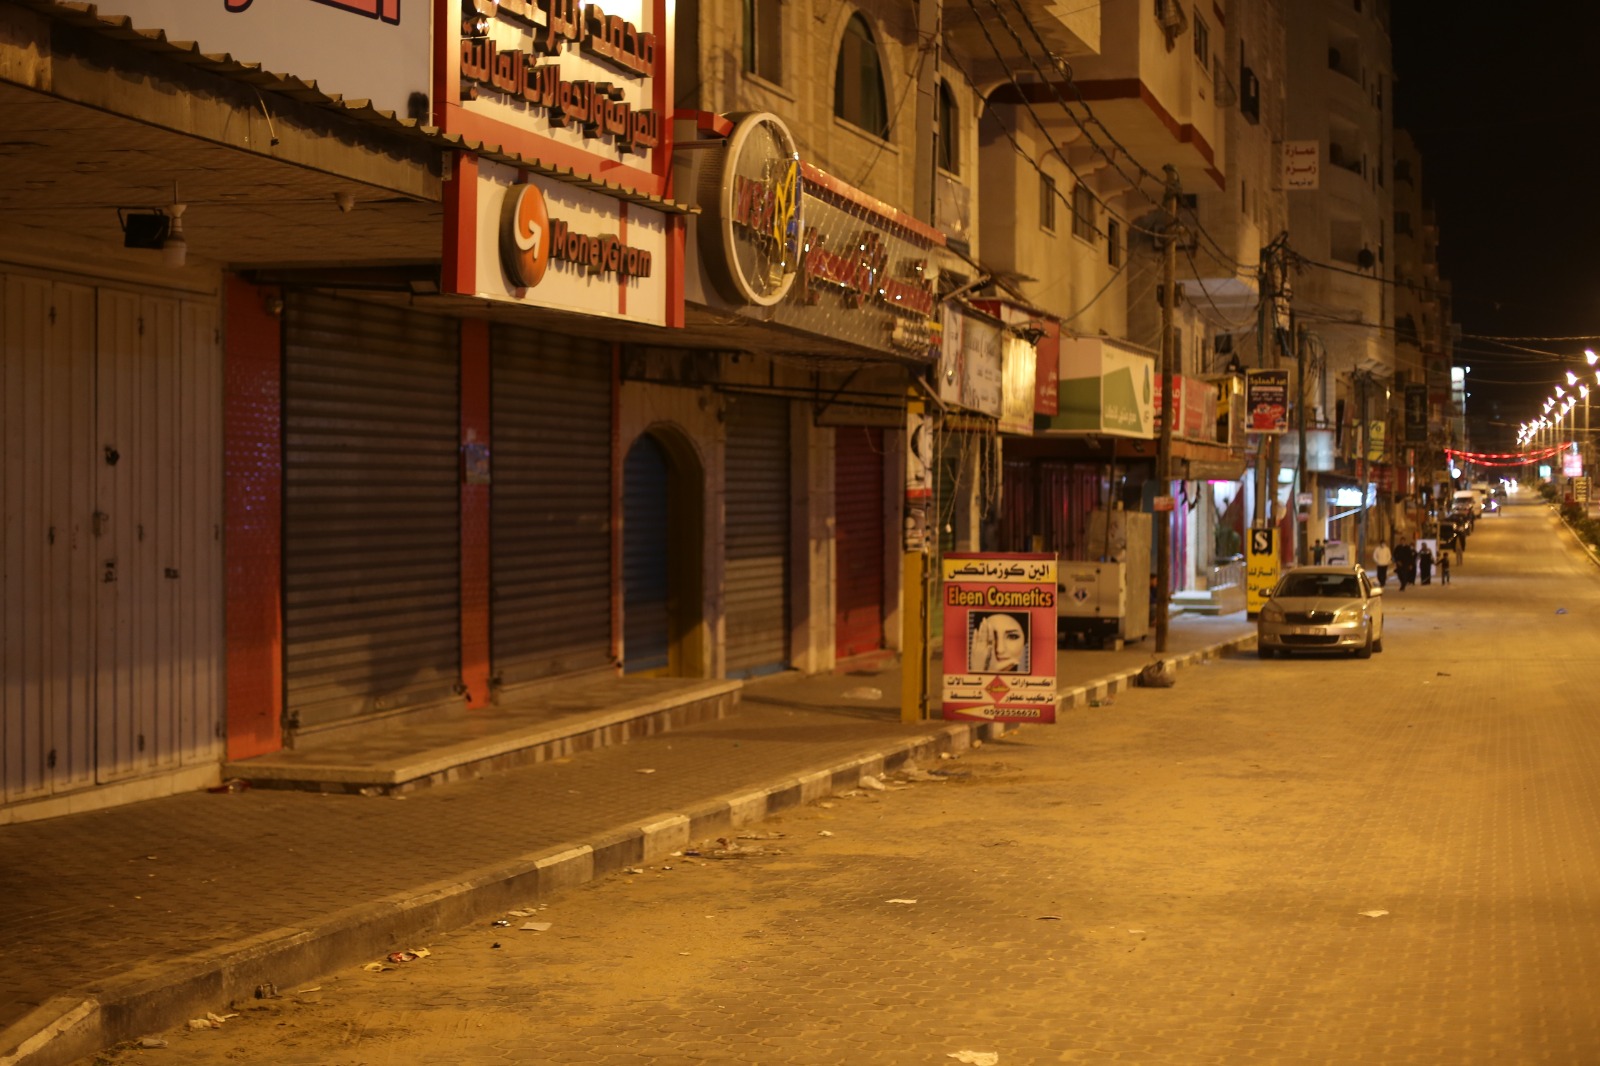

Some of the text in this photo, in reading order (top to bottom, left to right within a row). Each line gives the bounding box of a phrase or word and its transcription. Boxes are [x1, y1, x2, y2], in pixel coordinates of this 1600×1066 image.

[460, 38, 524, 100] المالية
[584, 4, 656, 78] محمد
[552, 218, 652, 278] MoneyGram
[1254, 531, 1268, 551] S
[948, 585, 1054, 607] Eleen Cosmetics
